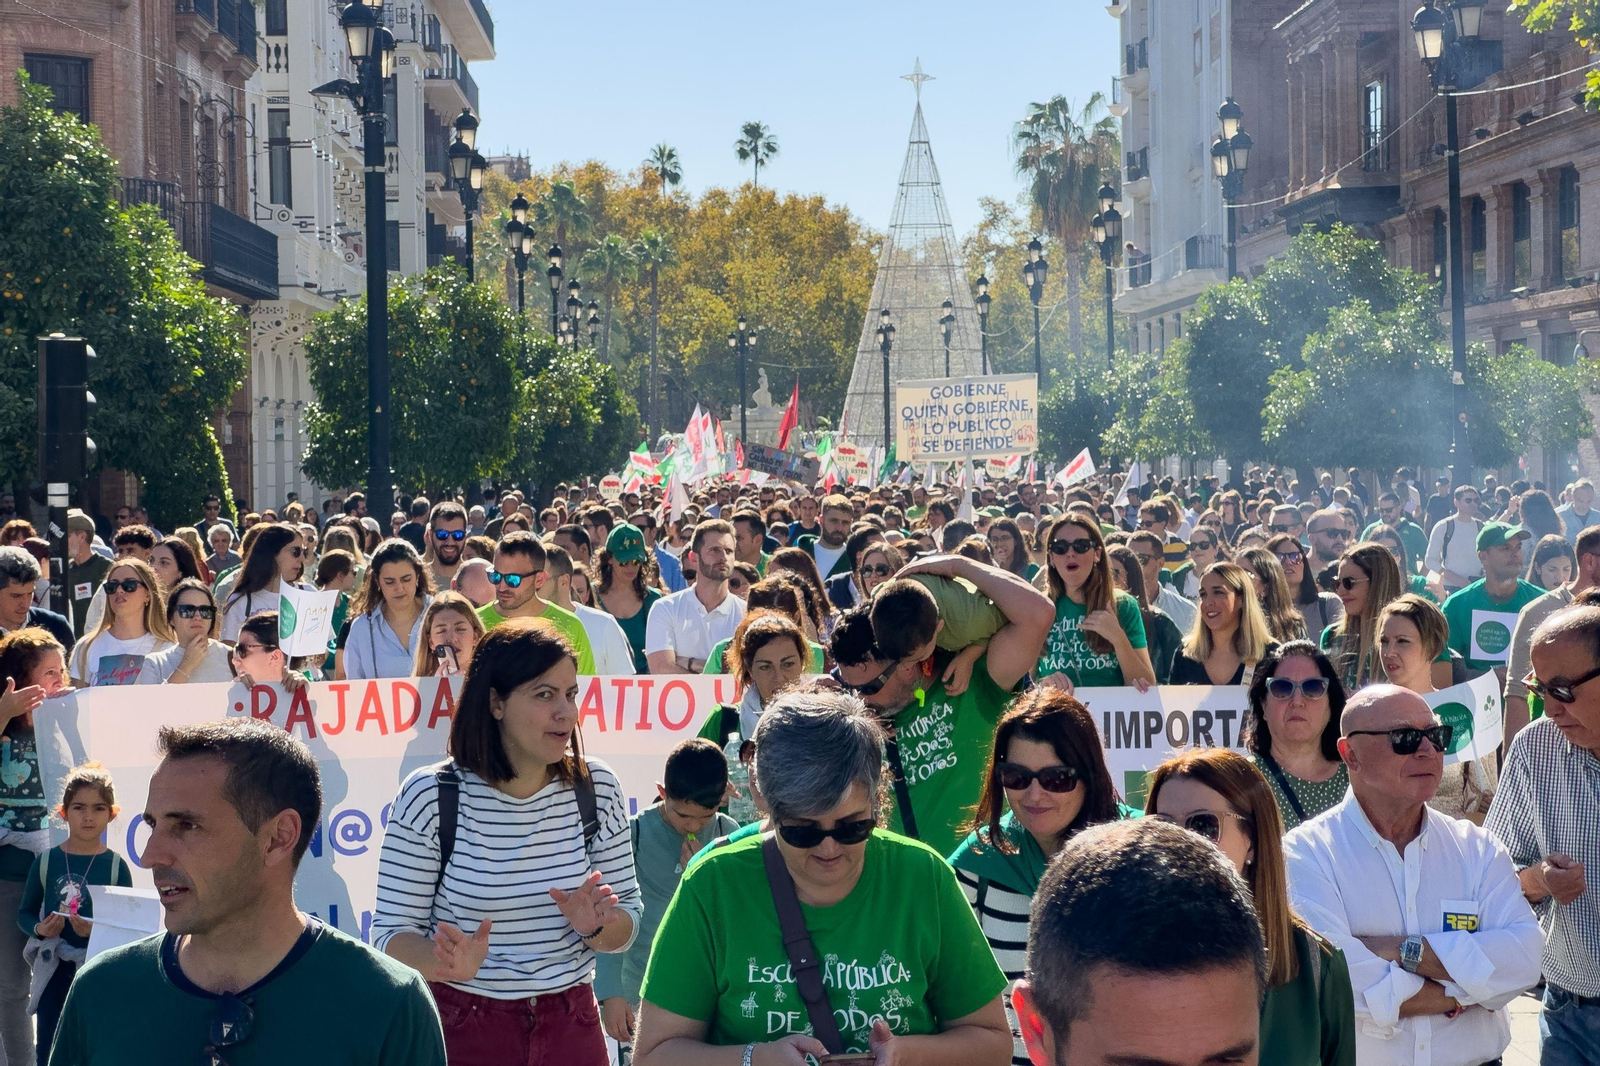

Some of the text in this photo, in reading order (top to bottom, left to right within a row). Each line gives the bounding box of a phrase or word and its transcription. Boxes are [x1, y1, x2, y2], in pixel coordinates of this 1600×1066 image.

[930, 383, 1006, 400] GOBIERNE
[901, 404, 949, 421] QUIEN
[953, 399, 1034, 416] GOBIERNE,
[924, 422, 944, 436] LO
[948, 417, 1012, 434] PUBLICO
[922, 440, 940, 453] SE
[944, 435, 1013, 452] DEFIENDE
[1446, 914, 1478, 931] RED
[767, 1010, 805, 1035] DE
